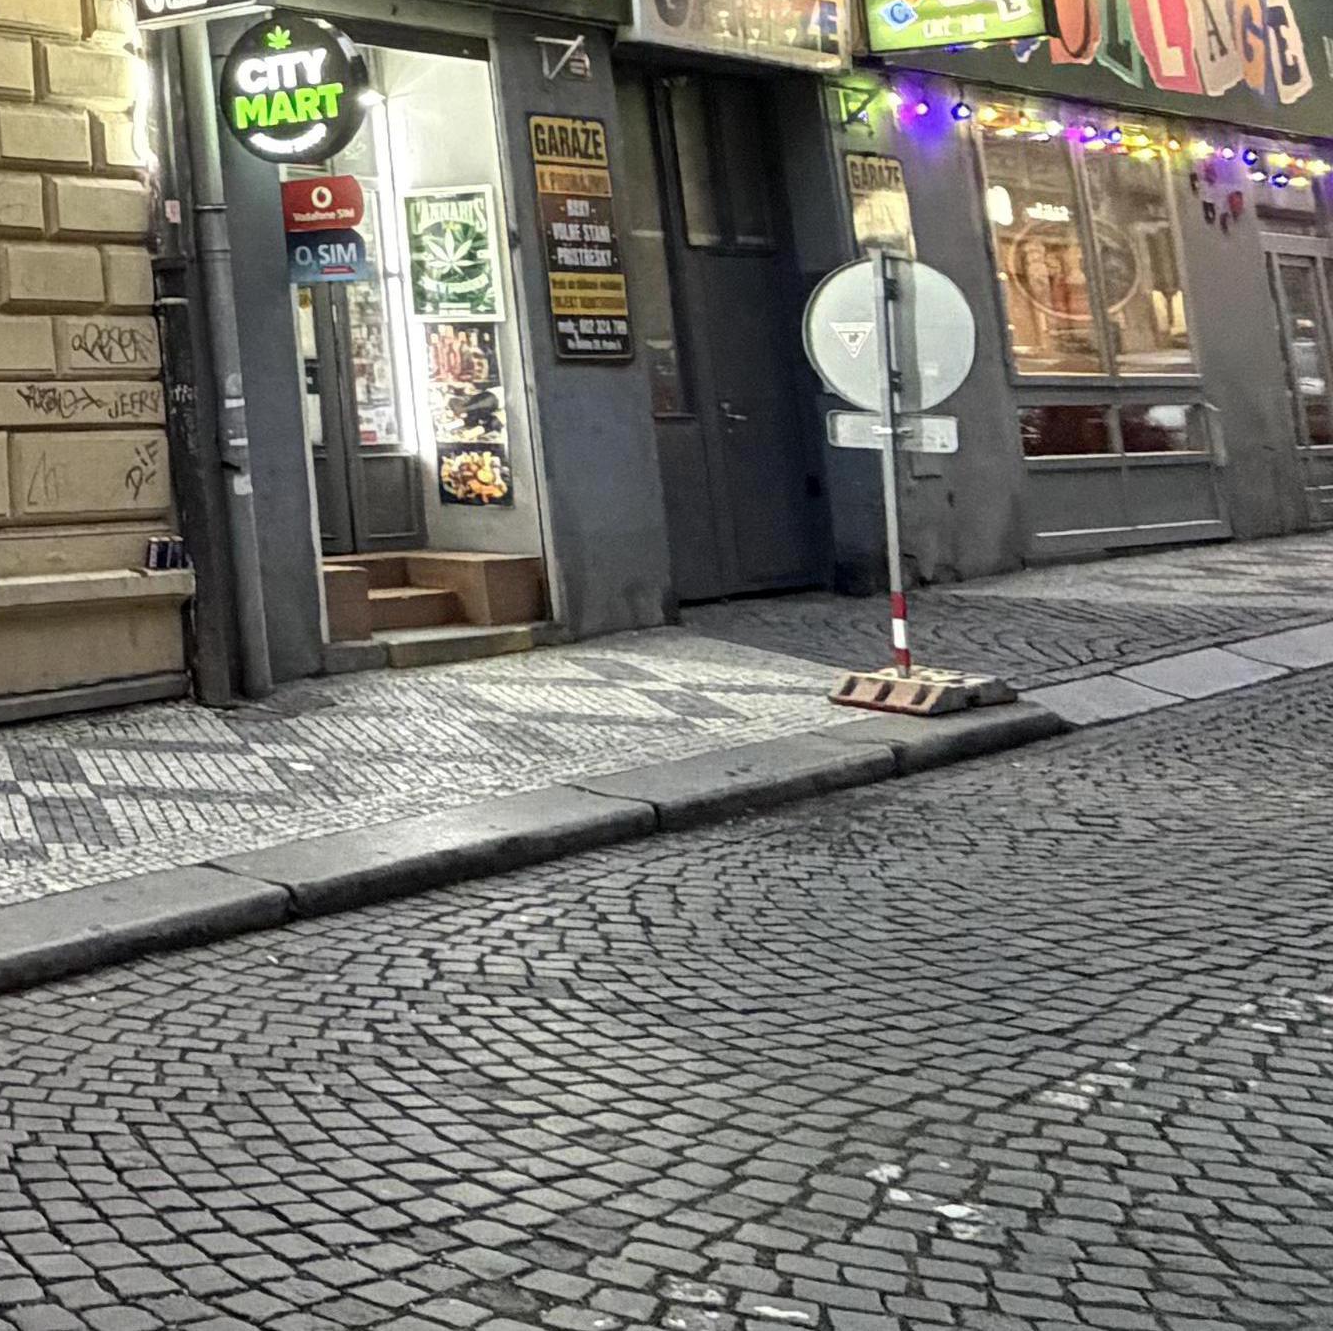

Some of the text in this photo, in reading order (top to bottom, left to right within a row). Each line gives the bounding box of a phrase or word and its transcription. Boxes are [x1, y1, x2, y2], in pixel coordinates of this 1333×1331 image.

[237, 48, 327, 93] CITY
[235, 83, 343, 129] MART
[410, 197, 487, 235] CANNABIS
[318, 242, 357, 265] SIM
